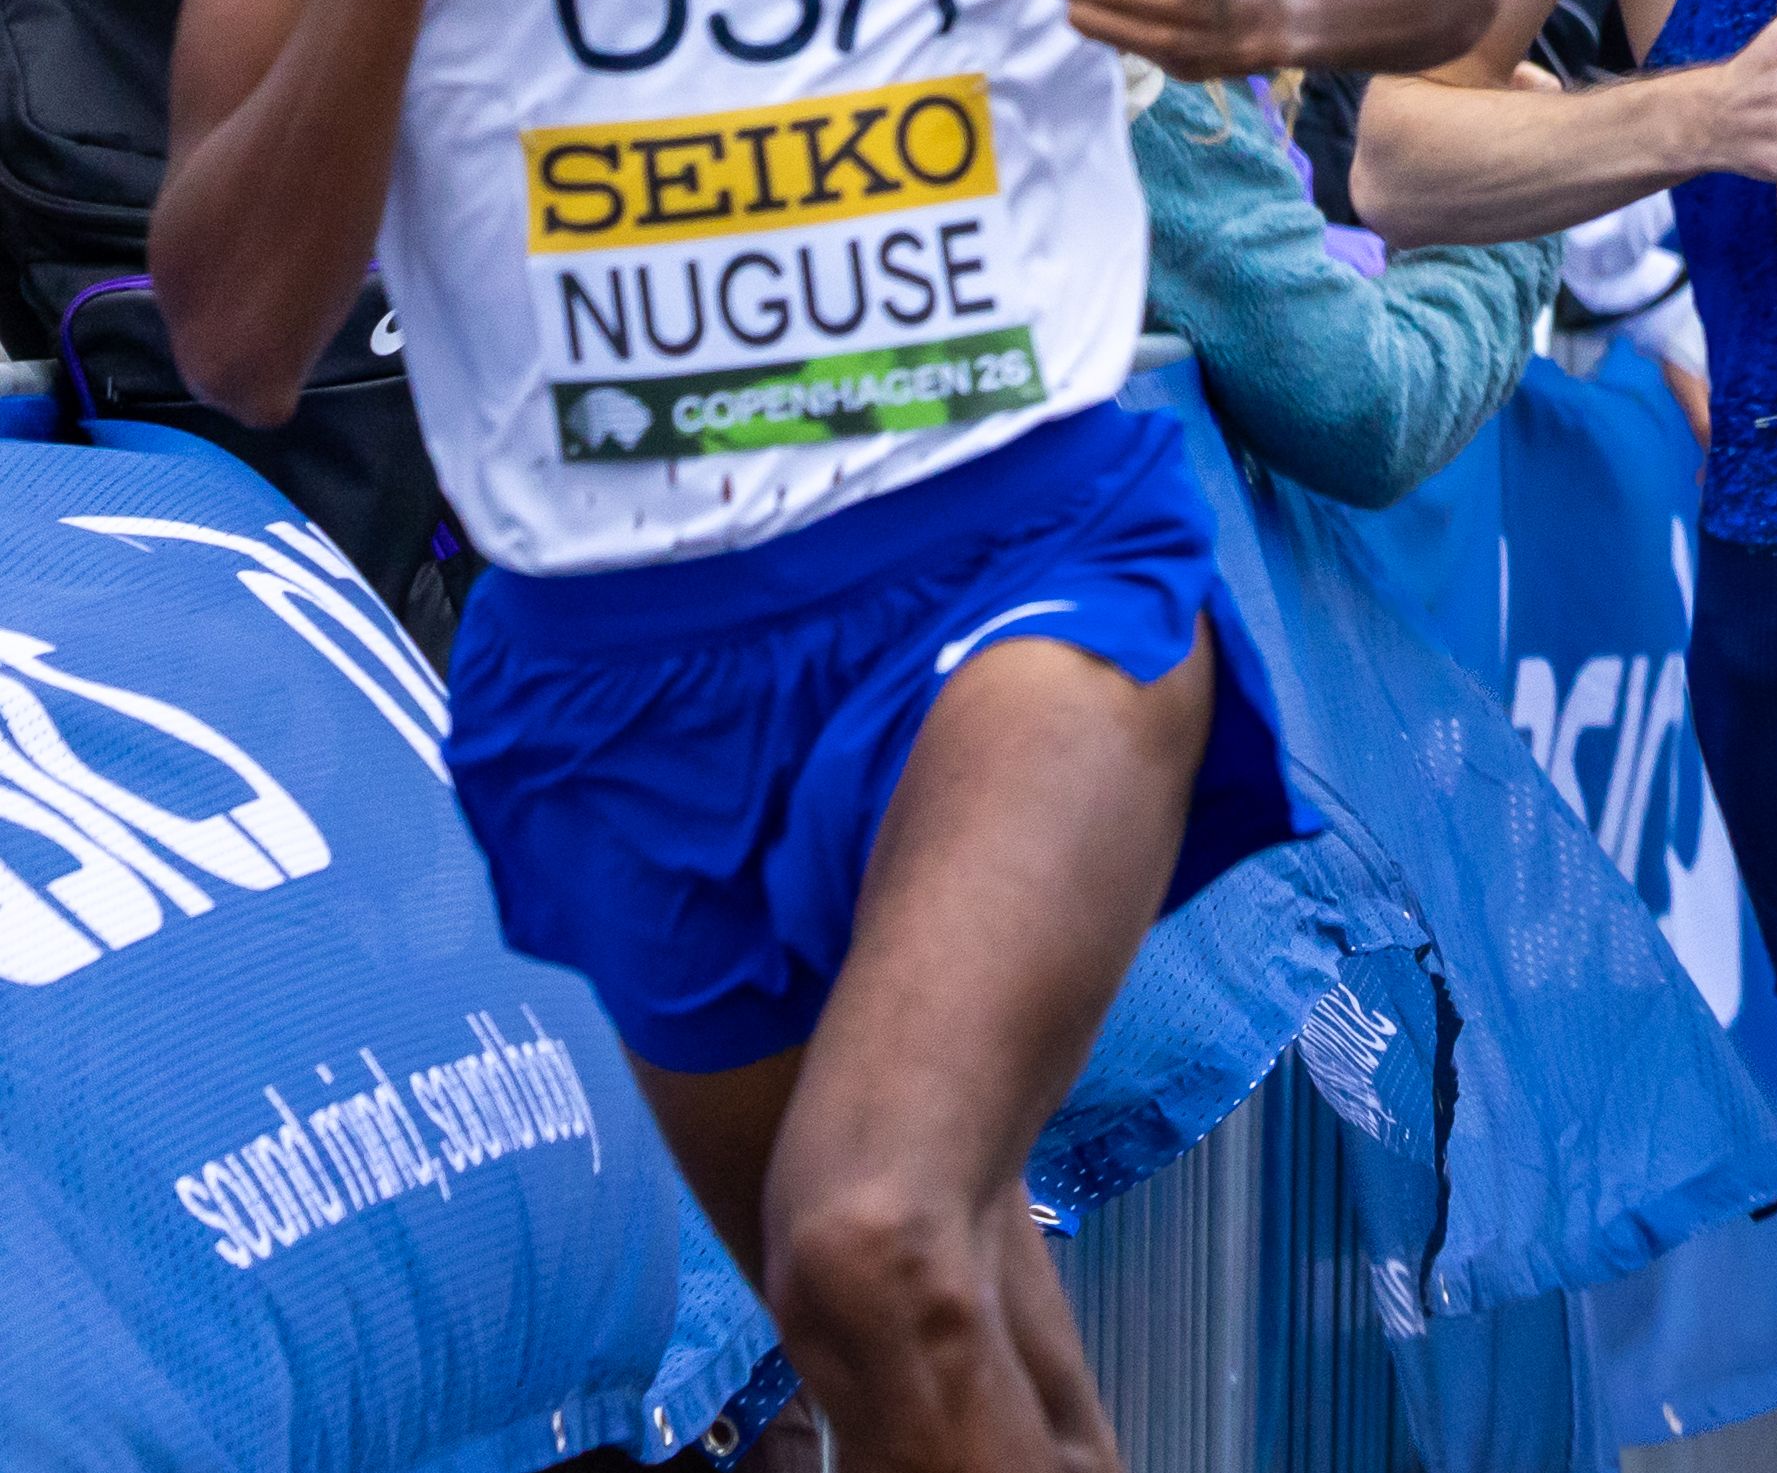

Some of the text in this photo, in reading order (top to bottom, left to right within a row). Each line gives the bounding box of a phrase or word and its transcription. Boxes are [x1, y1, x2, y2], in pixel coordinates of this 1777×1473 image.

[541, 95, 976, 236] SEIKO
[558, 221, 996, 364] NUGUSE
[671, 360, 972, 434] COPENHAGEN
[174, 1084, 347, 1269] sound
